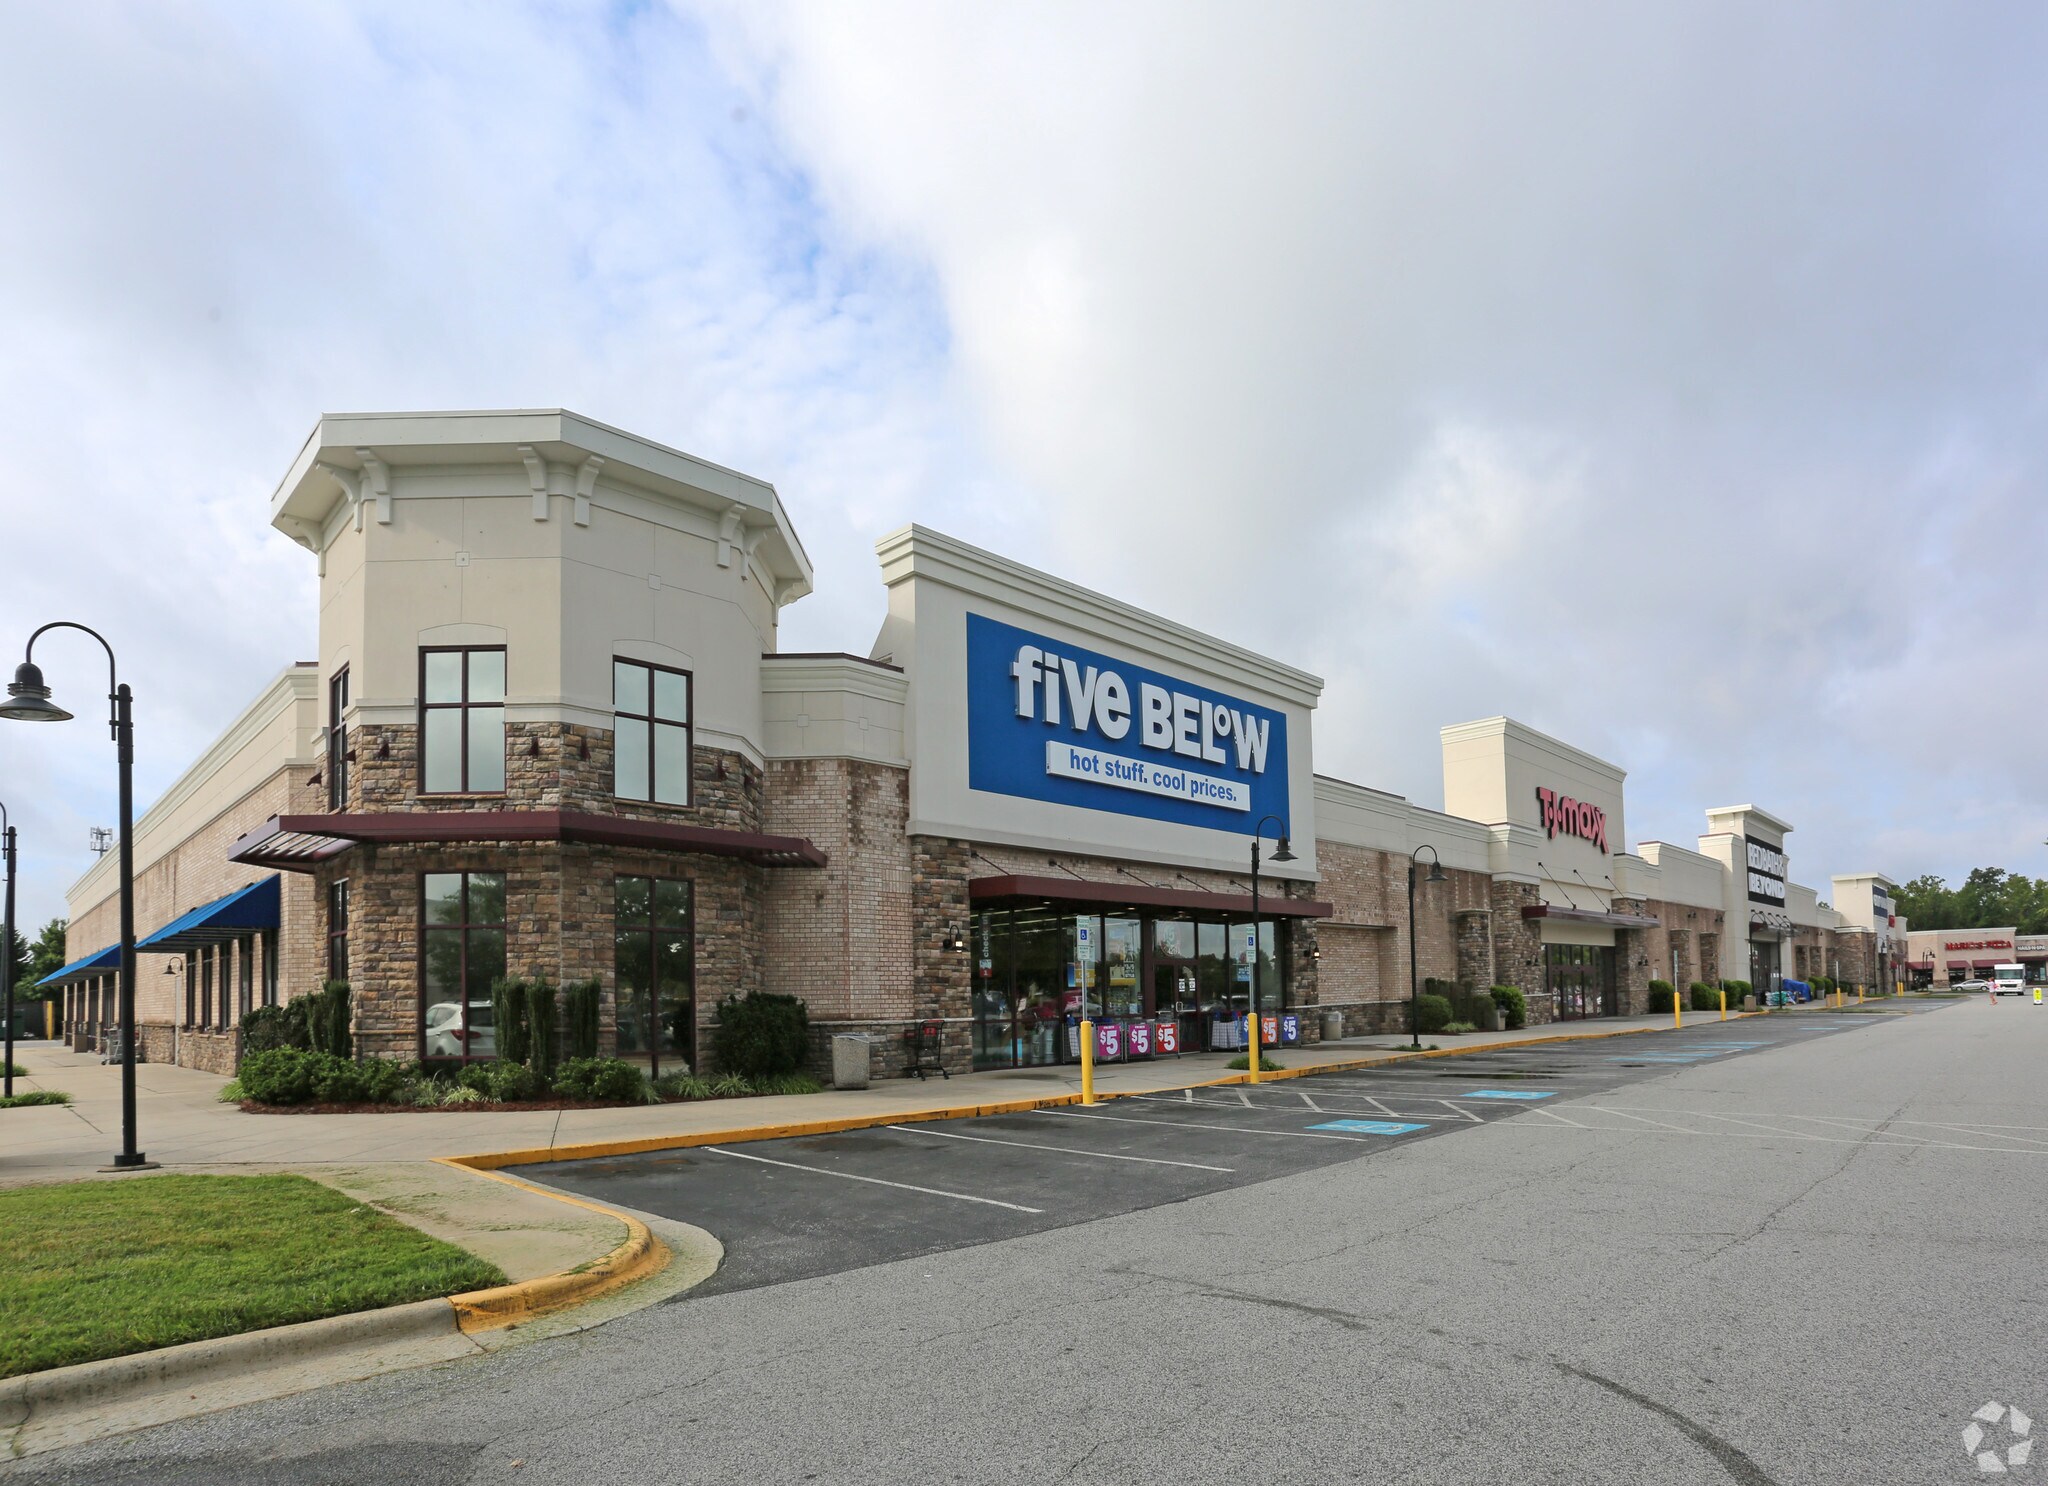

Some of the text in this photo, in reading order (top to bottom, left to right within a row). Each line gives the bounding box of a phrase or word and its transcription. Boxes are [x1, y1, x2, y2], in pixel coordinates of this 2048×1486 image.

[1012, 645, 1131, 740] five
[1070, 749, 1237, 802] hot stuff. cool prices.
[1748, 872, 1785, 899] BEYOND
[1131, 1029, 1149, 1053] $5
[1158, 1028, 1176, 1051] $5
[1263, 1021, 1277, 1042] $5
[1283, 1020, 1297, 1040] $5
[1100, 1030, 1119, 1055] $5
